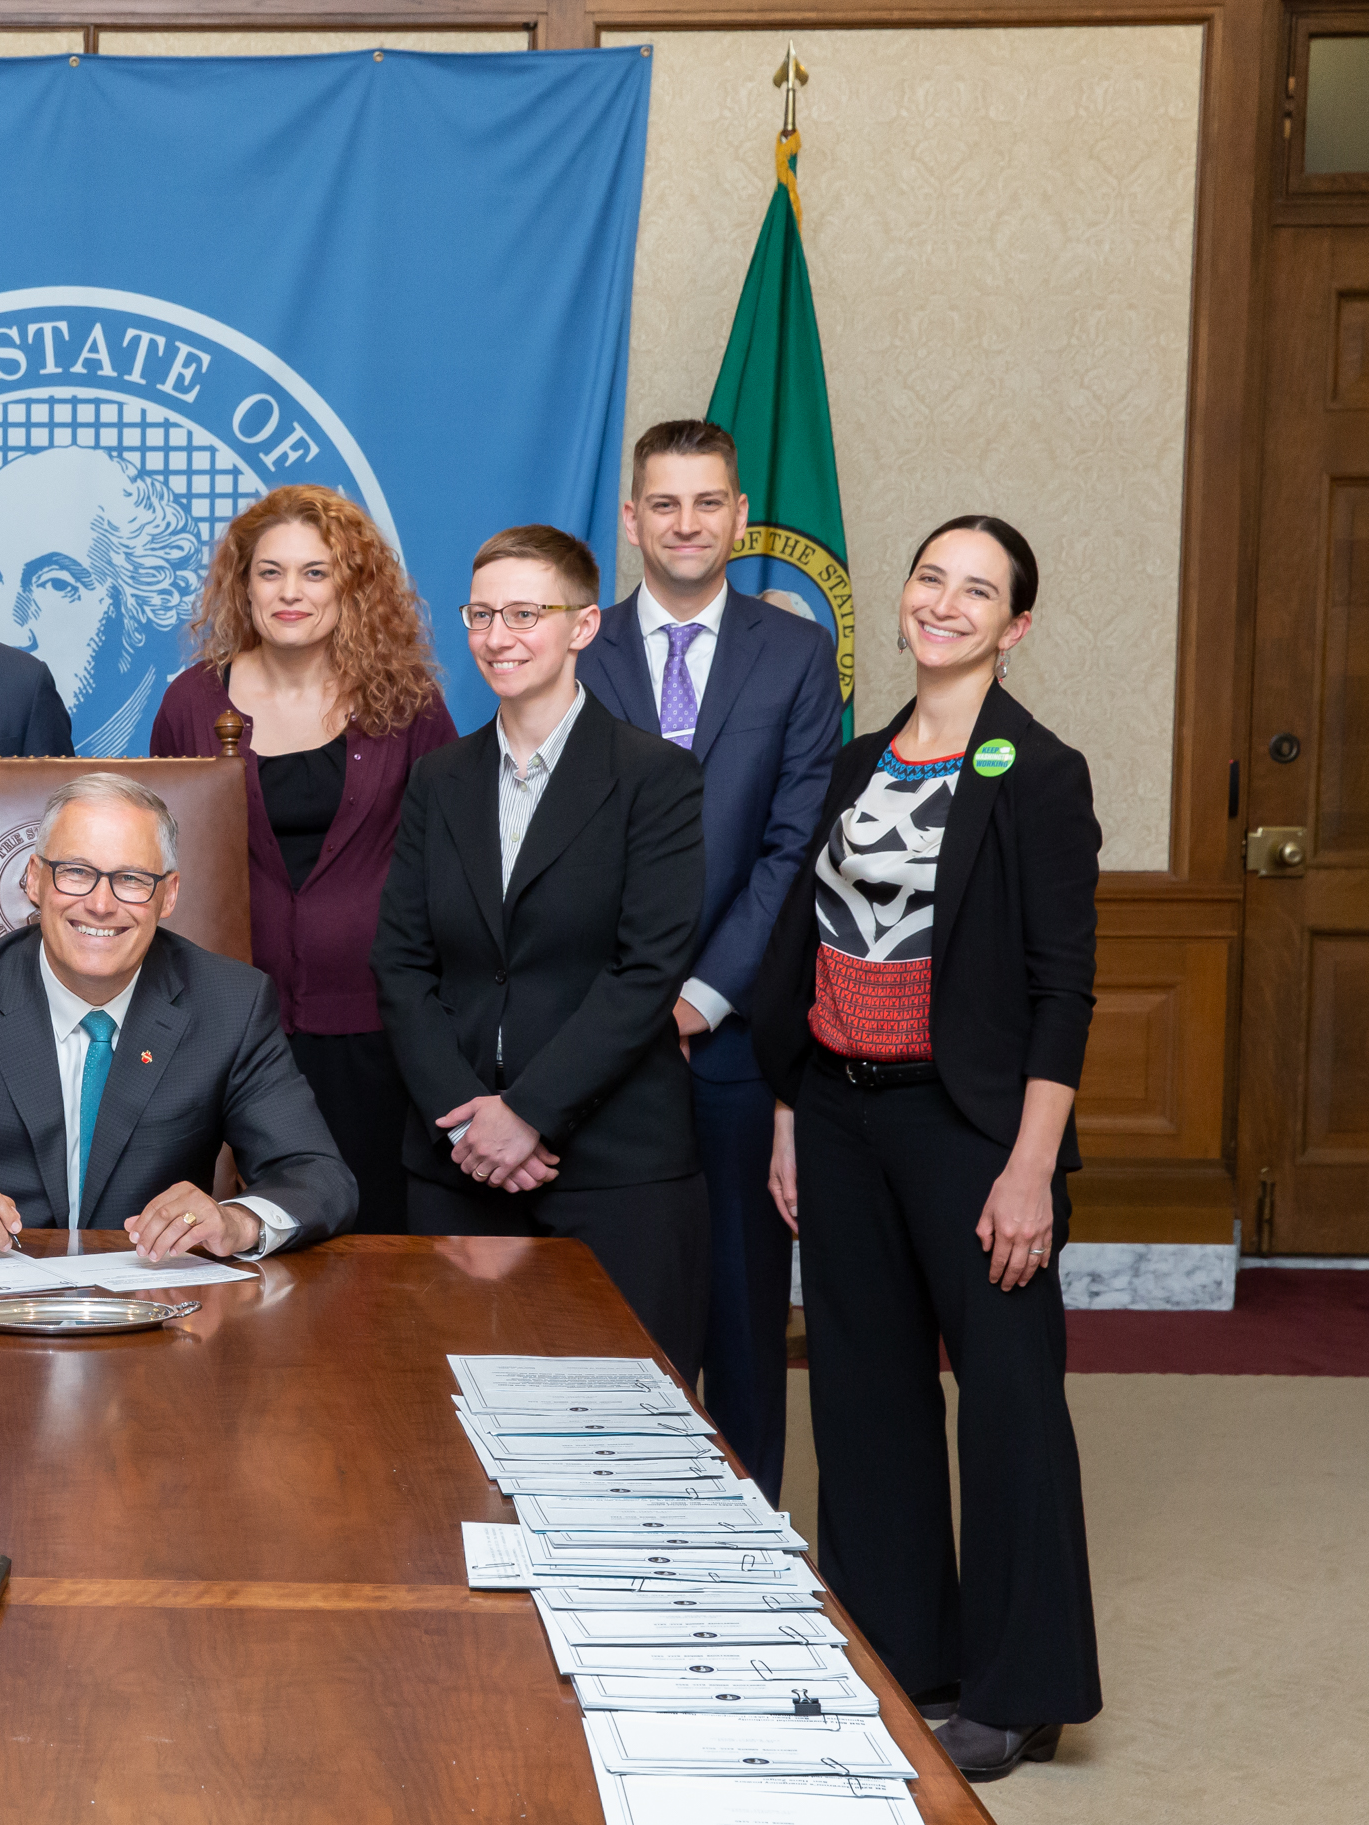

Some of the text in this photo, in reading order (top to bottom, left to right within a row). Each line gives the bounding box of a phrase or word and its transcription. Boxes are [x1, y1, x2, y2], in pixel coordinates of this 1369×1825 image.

[232, 393, 320, 472] OF
[769, 532, 816, 566] THE
[817, 563, 854, 639] STATE
[839, 653, 855, 687] OF
[976, 760, 1009, 768] WORKING
